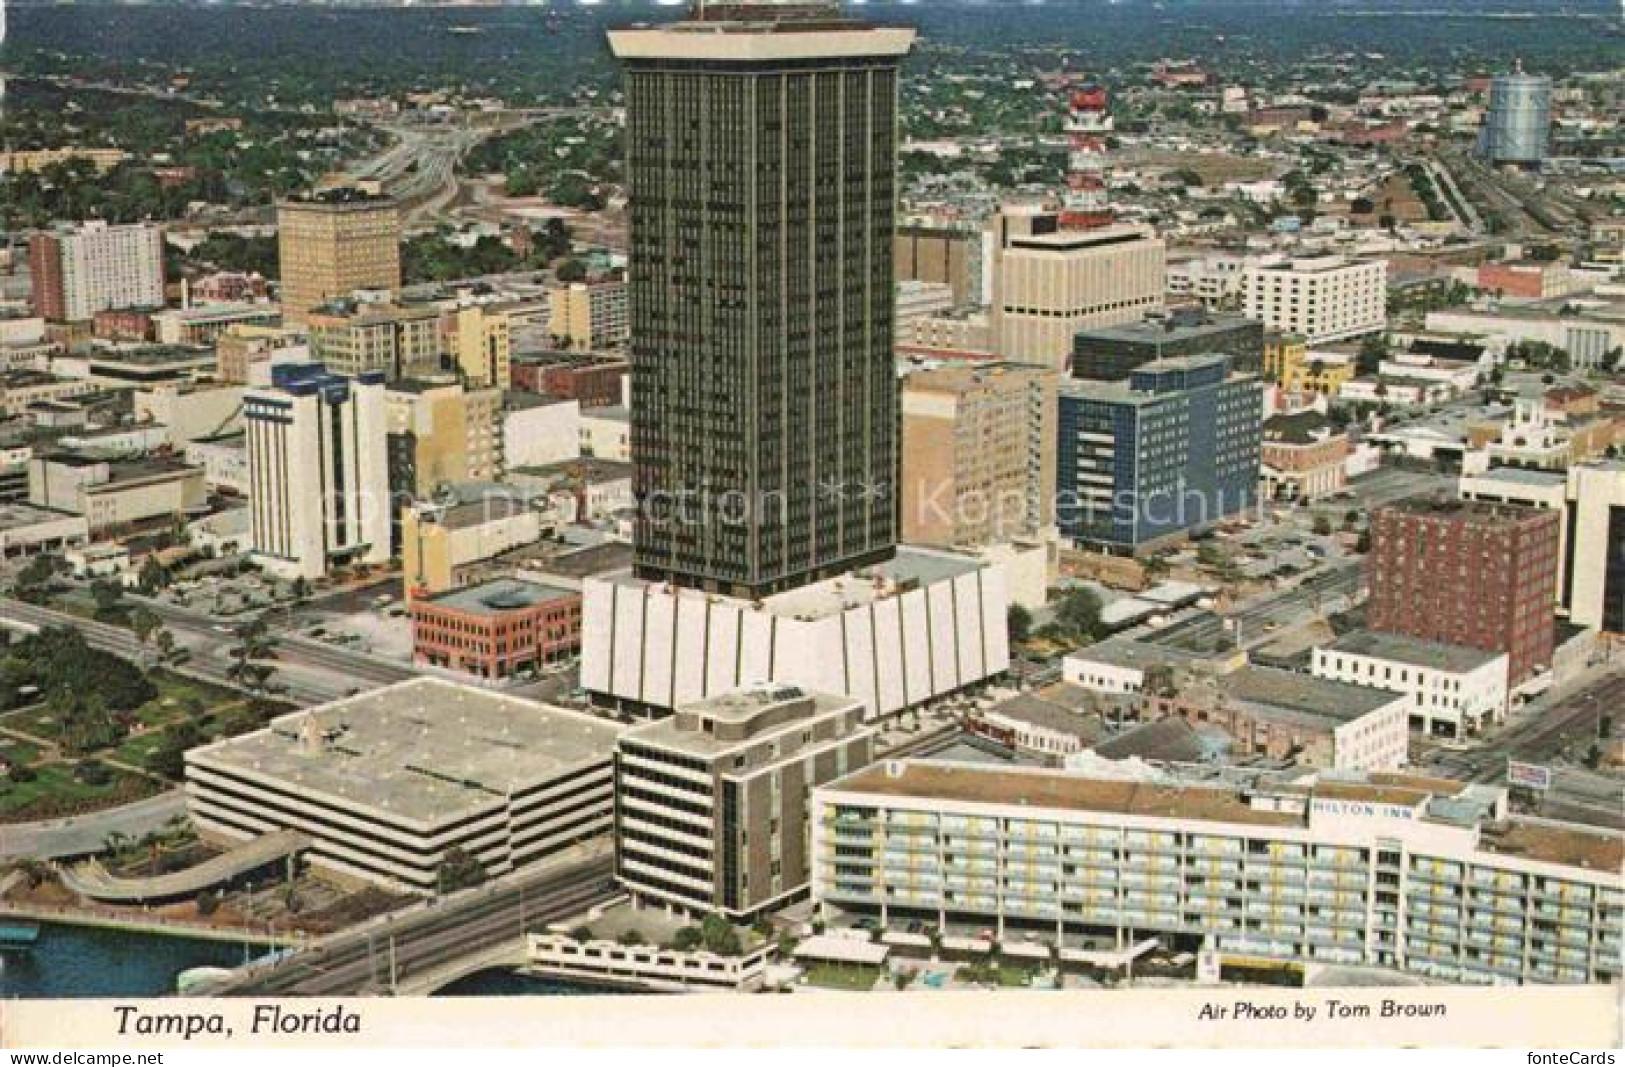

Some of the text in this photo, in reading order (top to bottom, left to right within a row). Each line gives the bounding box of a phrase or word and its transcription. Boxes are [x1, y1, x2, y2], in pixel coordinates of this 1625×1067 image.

[1313, 801, 1412, 819] HILTON INN
[1197, 999, 1448, 1022] Air Photo by Tom Brown
[113, 1004, 362, 1041] Tampa, Florida
